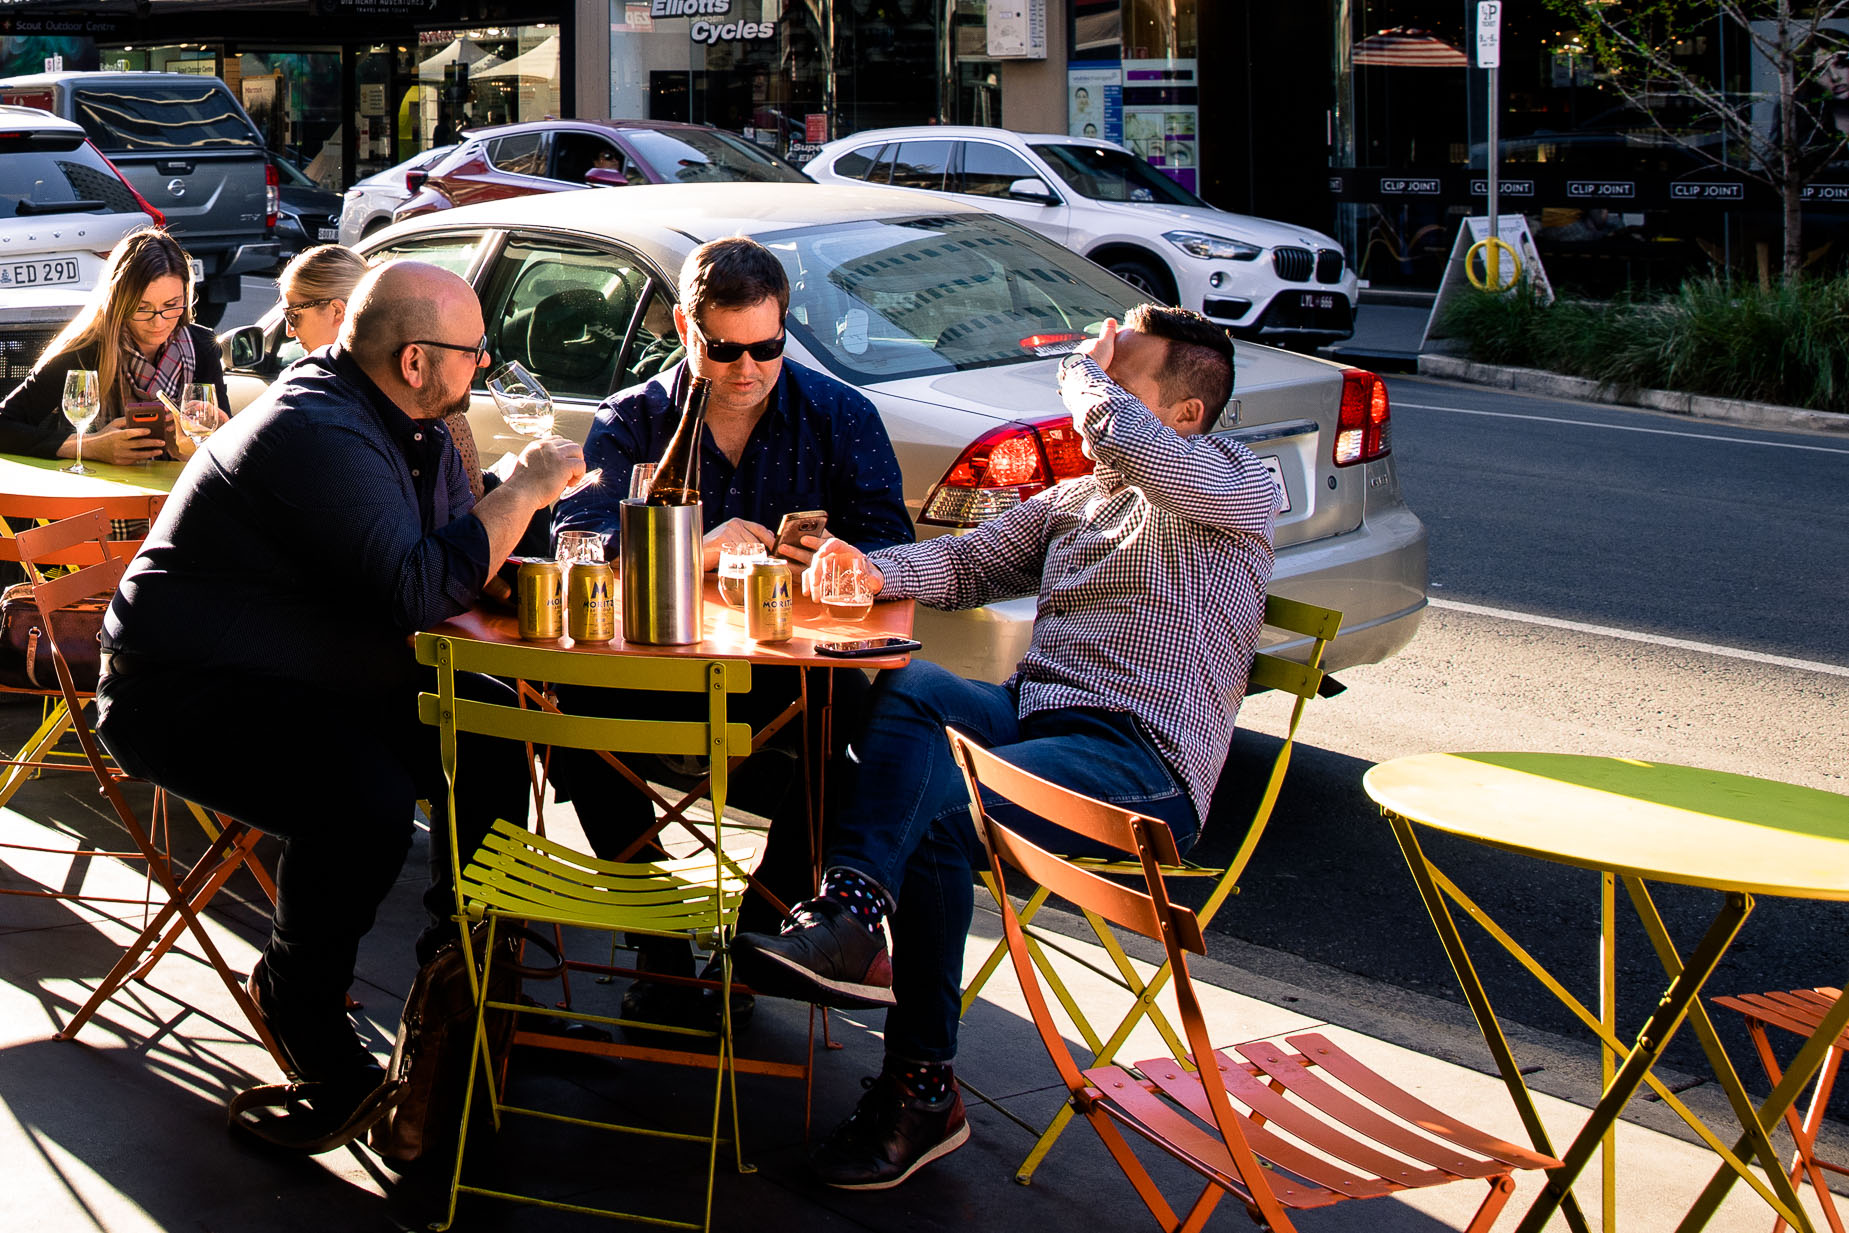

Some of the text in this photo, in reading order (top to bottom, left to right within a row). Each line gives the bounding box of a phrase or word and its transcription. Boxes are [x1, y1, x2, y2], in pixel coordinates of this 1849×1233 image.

[45, 20, 82, 31] Outdoor
[691, 20, 775, 44] Cycles
[1384, 181, 1436, 192] CLIP JOINT
[1571, 184, 1630, 195] CLIP JOINT
[1675, 185, 1739, 196] CLIP JOINT
